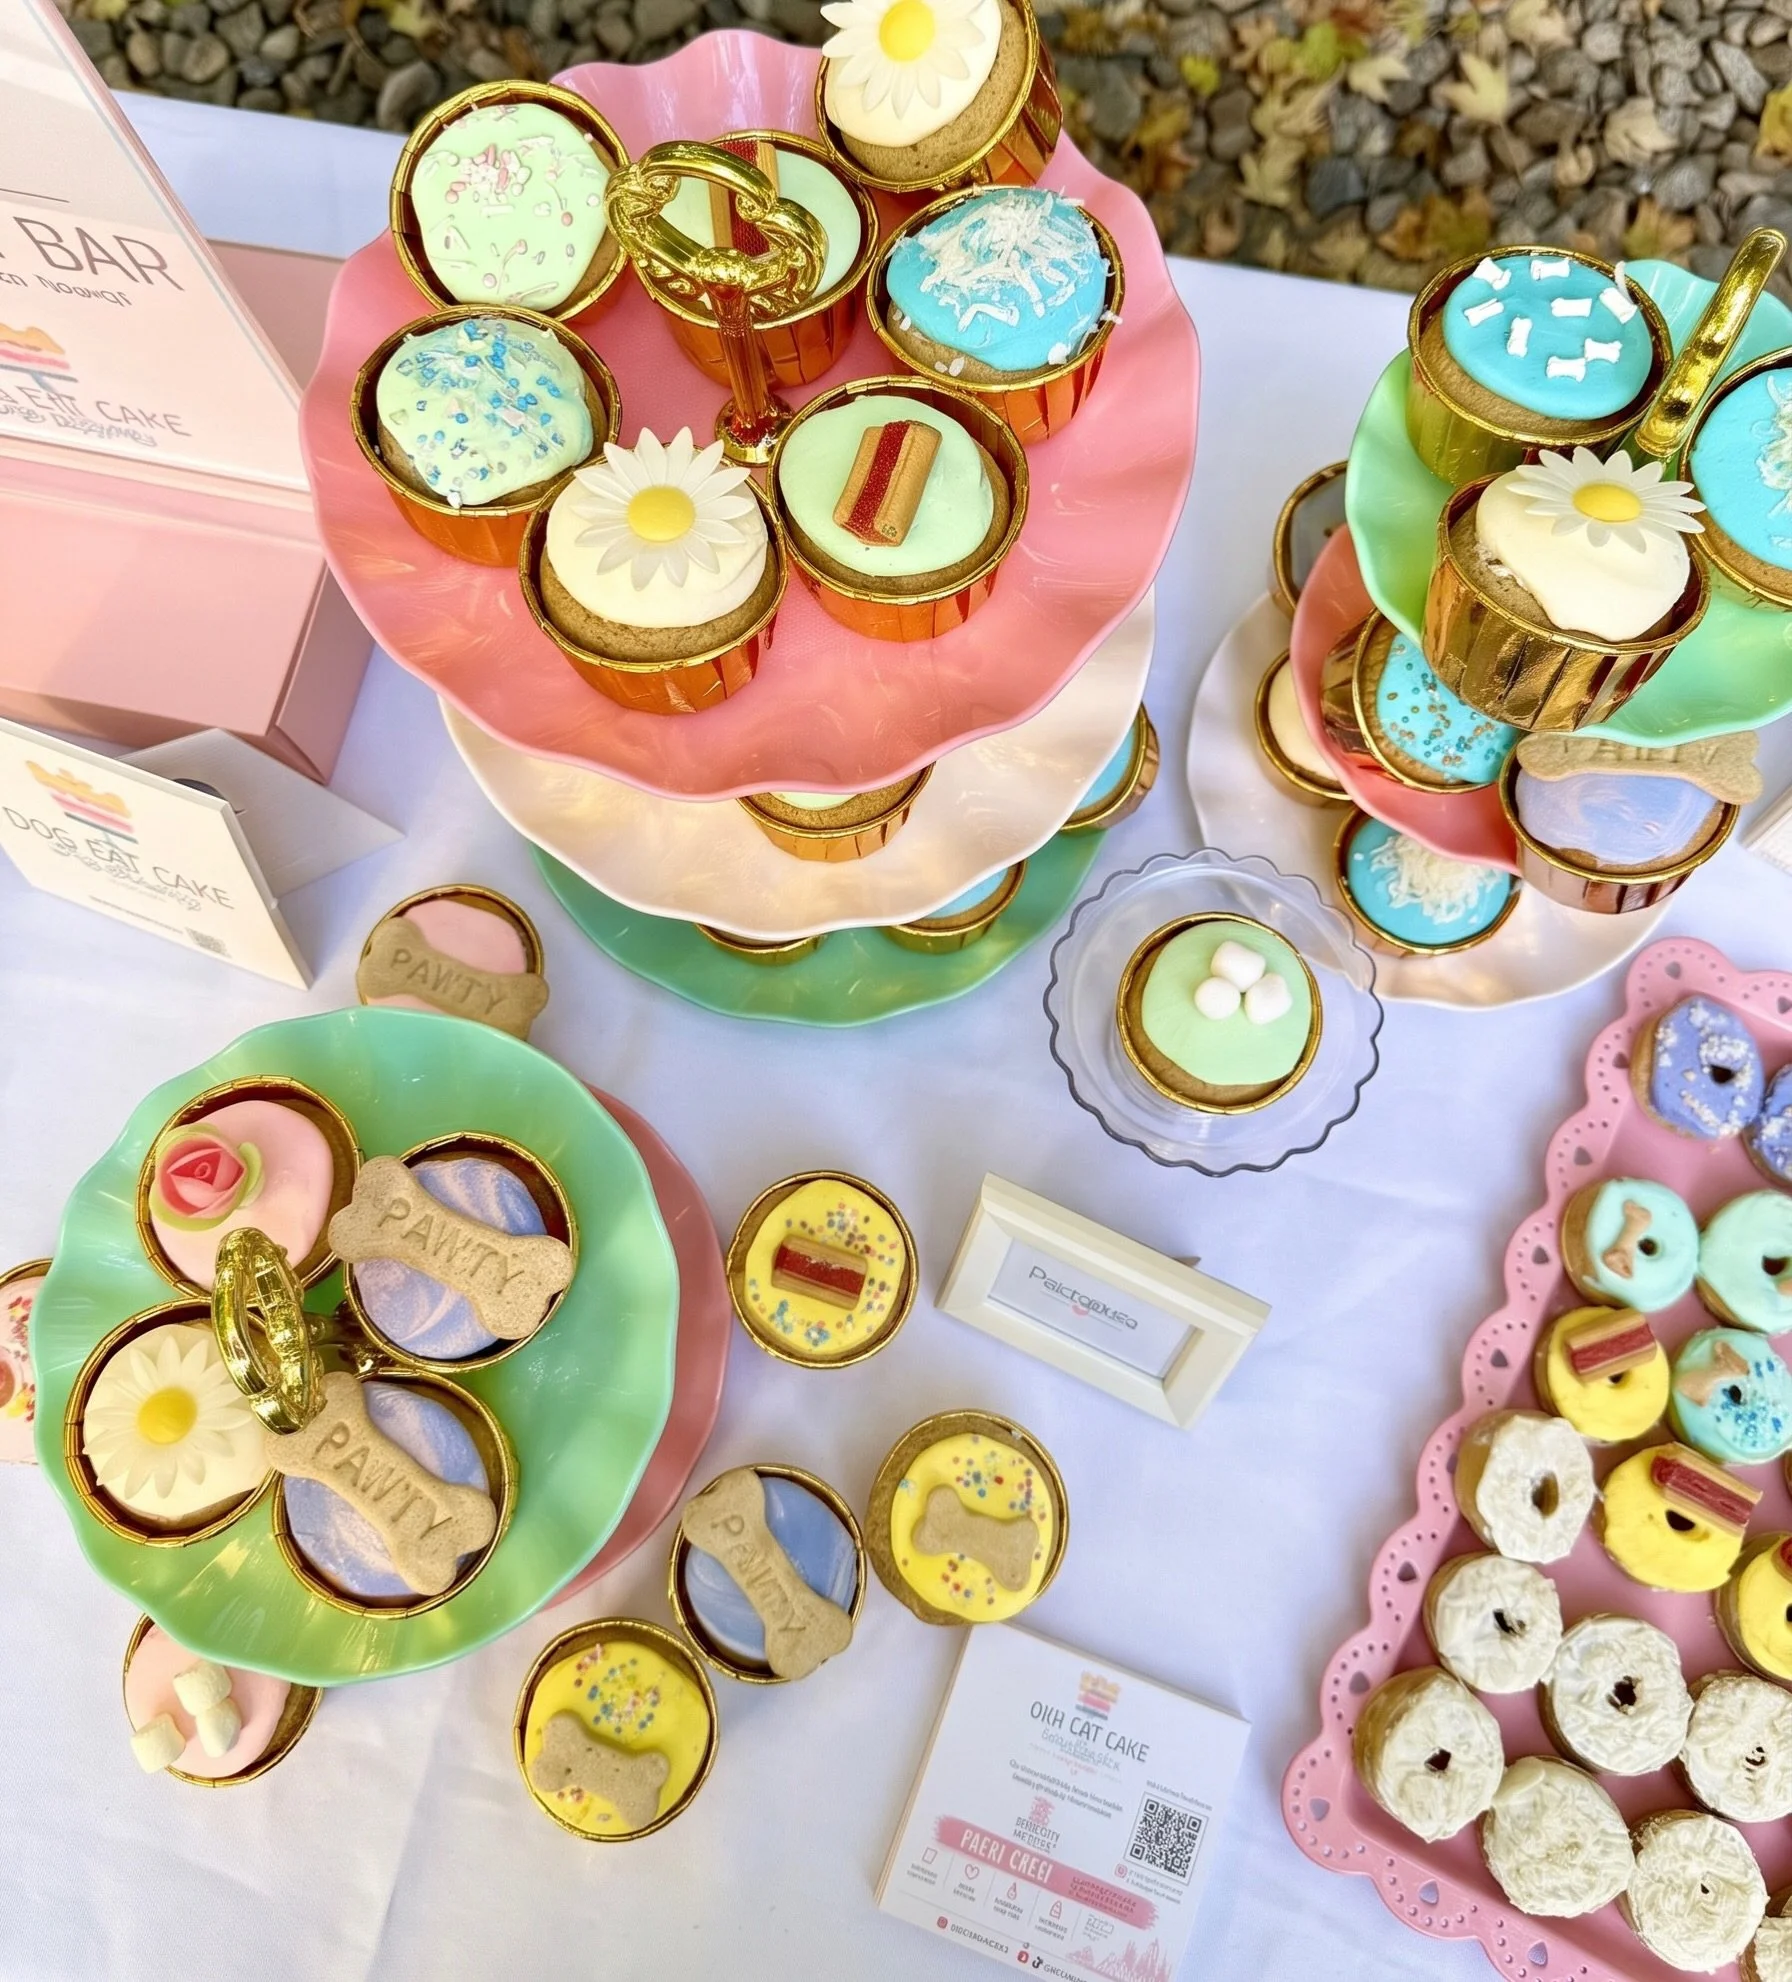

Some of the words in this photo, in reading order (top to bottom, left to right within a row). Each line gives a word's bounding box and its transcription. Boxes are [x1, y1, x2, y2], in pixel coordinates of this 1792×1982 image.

[13, 216, 184, 292] BAR
[95, 400, 192, 437] CAKE
[2, 806, 77, 850] DOG
[85, 838, 140, 874] EAT
[152, 866, 235, 910] CAKE
[390, 948, 506, 1015] PAWTY
[376, 1196, 525, 1295] PAWTY
[312, 1421, 452, 1540] PAWTY
[1070, 1716, 1103, 1742] CAT
[1105, 1731, 1150, 1763] CAKE
